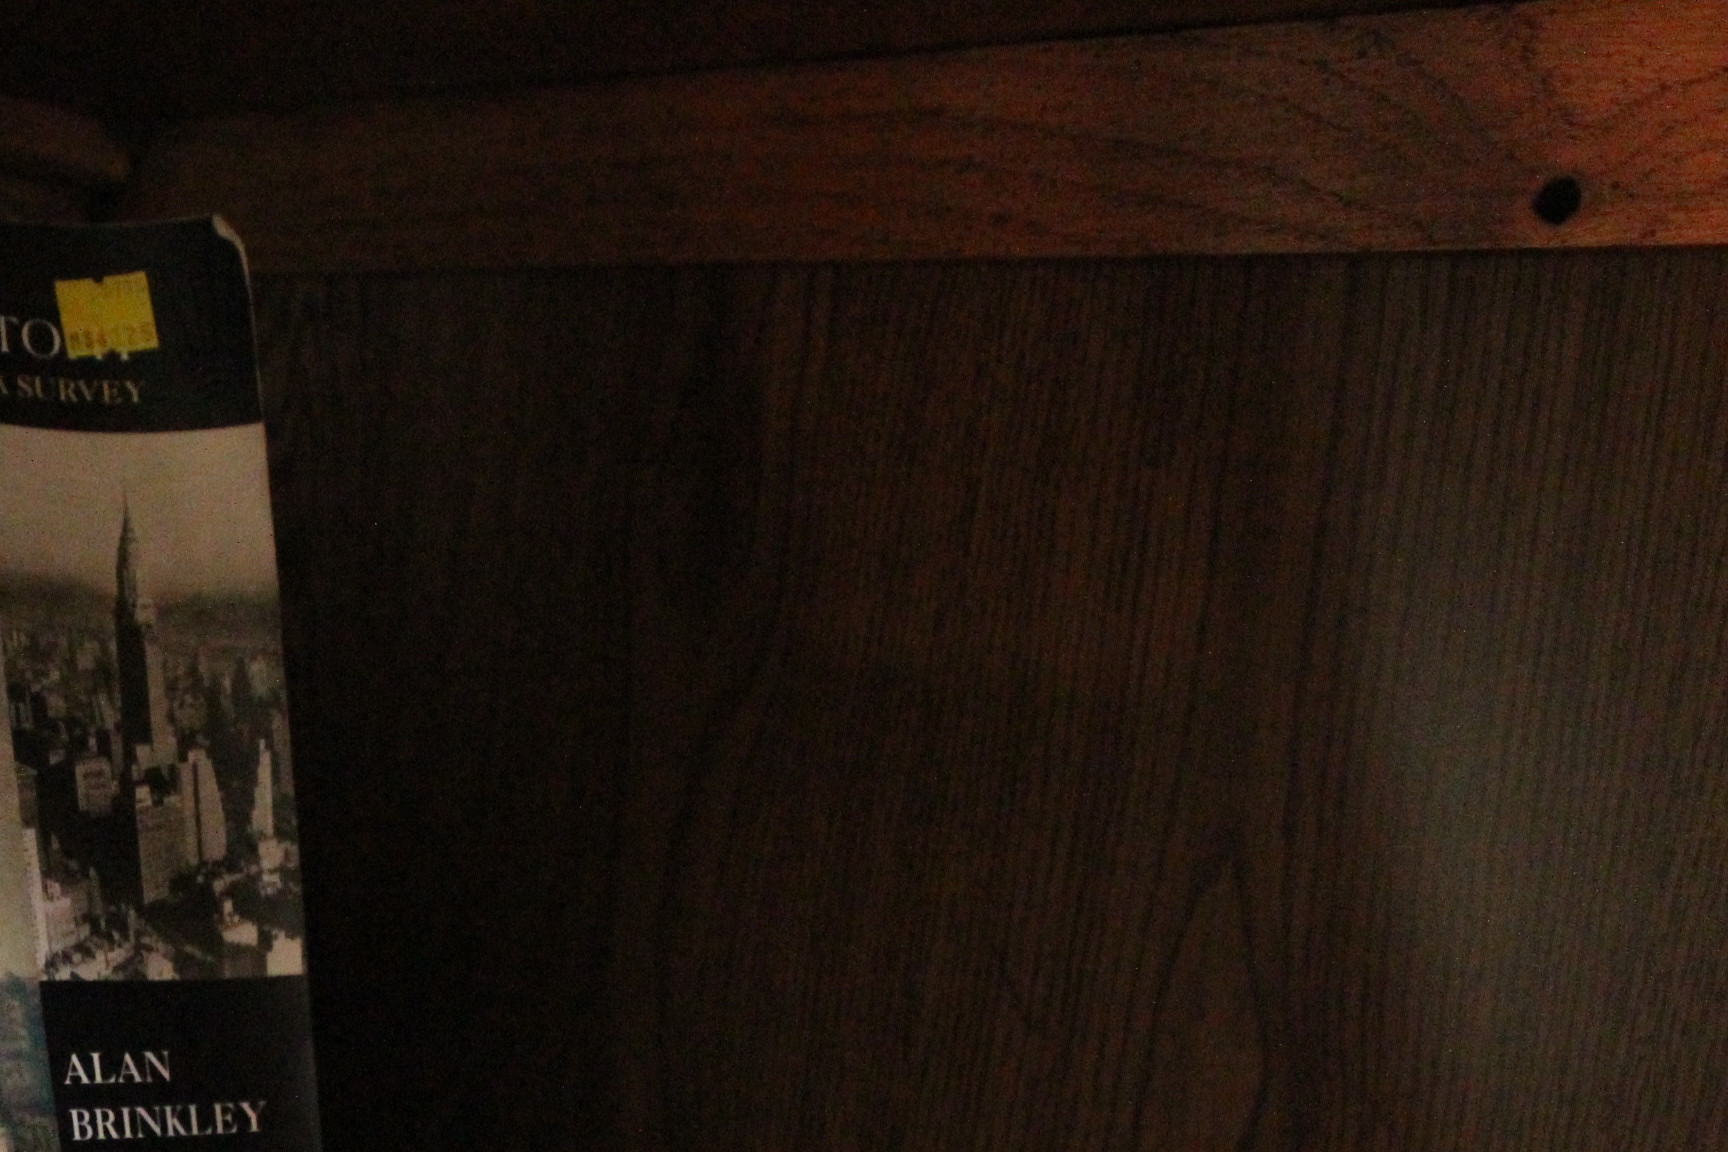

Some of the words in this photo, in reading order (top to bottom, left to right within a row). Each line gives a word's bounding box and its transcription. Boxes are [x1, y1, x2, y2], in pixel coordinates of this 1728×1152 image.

[15, 375, 145, 407] SURVEY
[63, 1050, 172, 1085] ALAN
[68, 1100, 268, 1142] BRINKLEY
